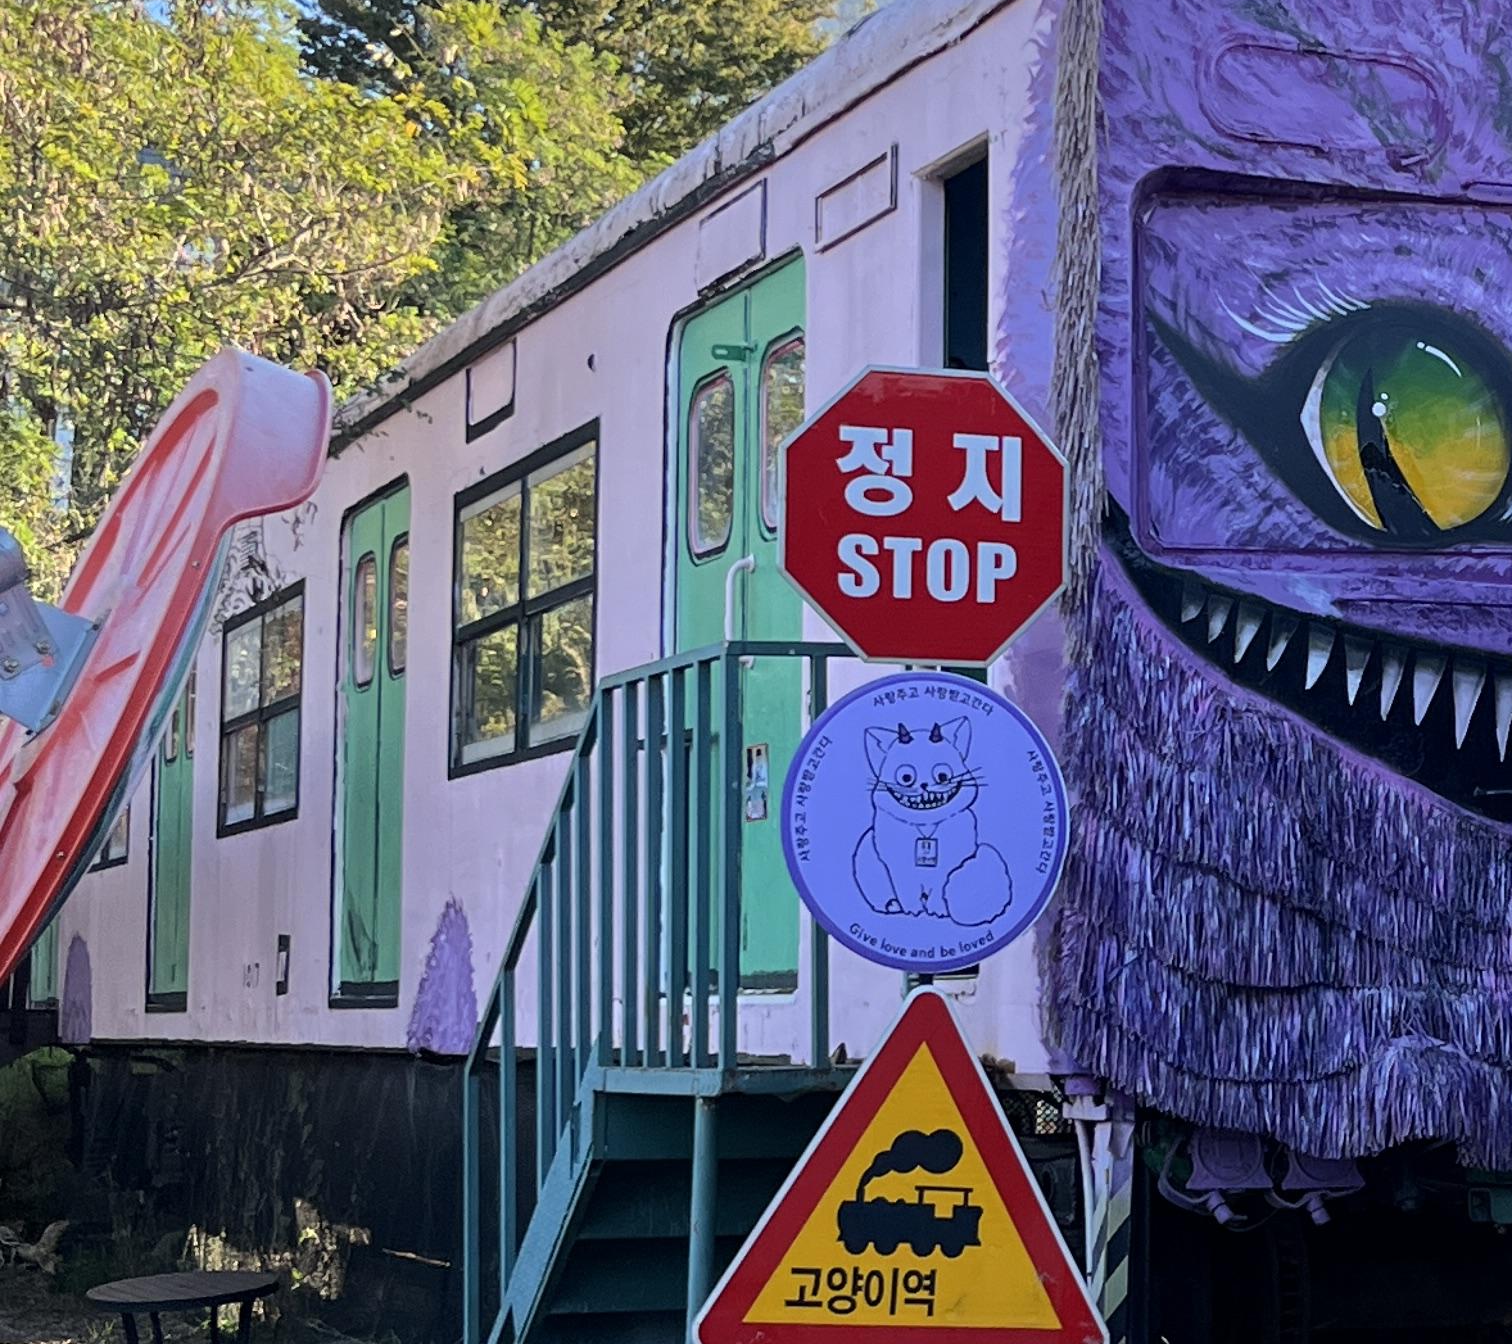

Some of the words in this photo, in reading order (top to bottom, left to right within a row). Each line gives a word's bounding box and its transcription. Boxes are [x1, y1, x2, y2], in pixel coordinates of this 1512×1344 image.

[837, 533, 1018, 604] STOP
[873, 686, 919, 707] 사랑주고
[849, 923, 877, 946] Give
[881, 937, 908, 957] love
[910, 947, 935, 958] and
[940, 946, 956, 958] be
[959, 930, 995, 953] loved
[784, 1266, 937, 1317] 고양이역
